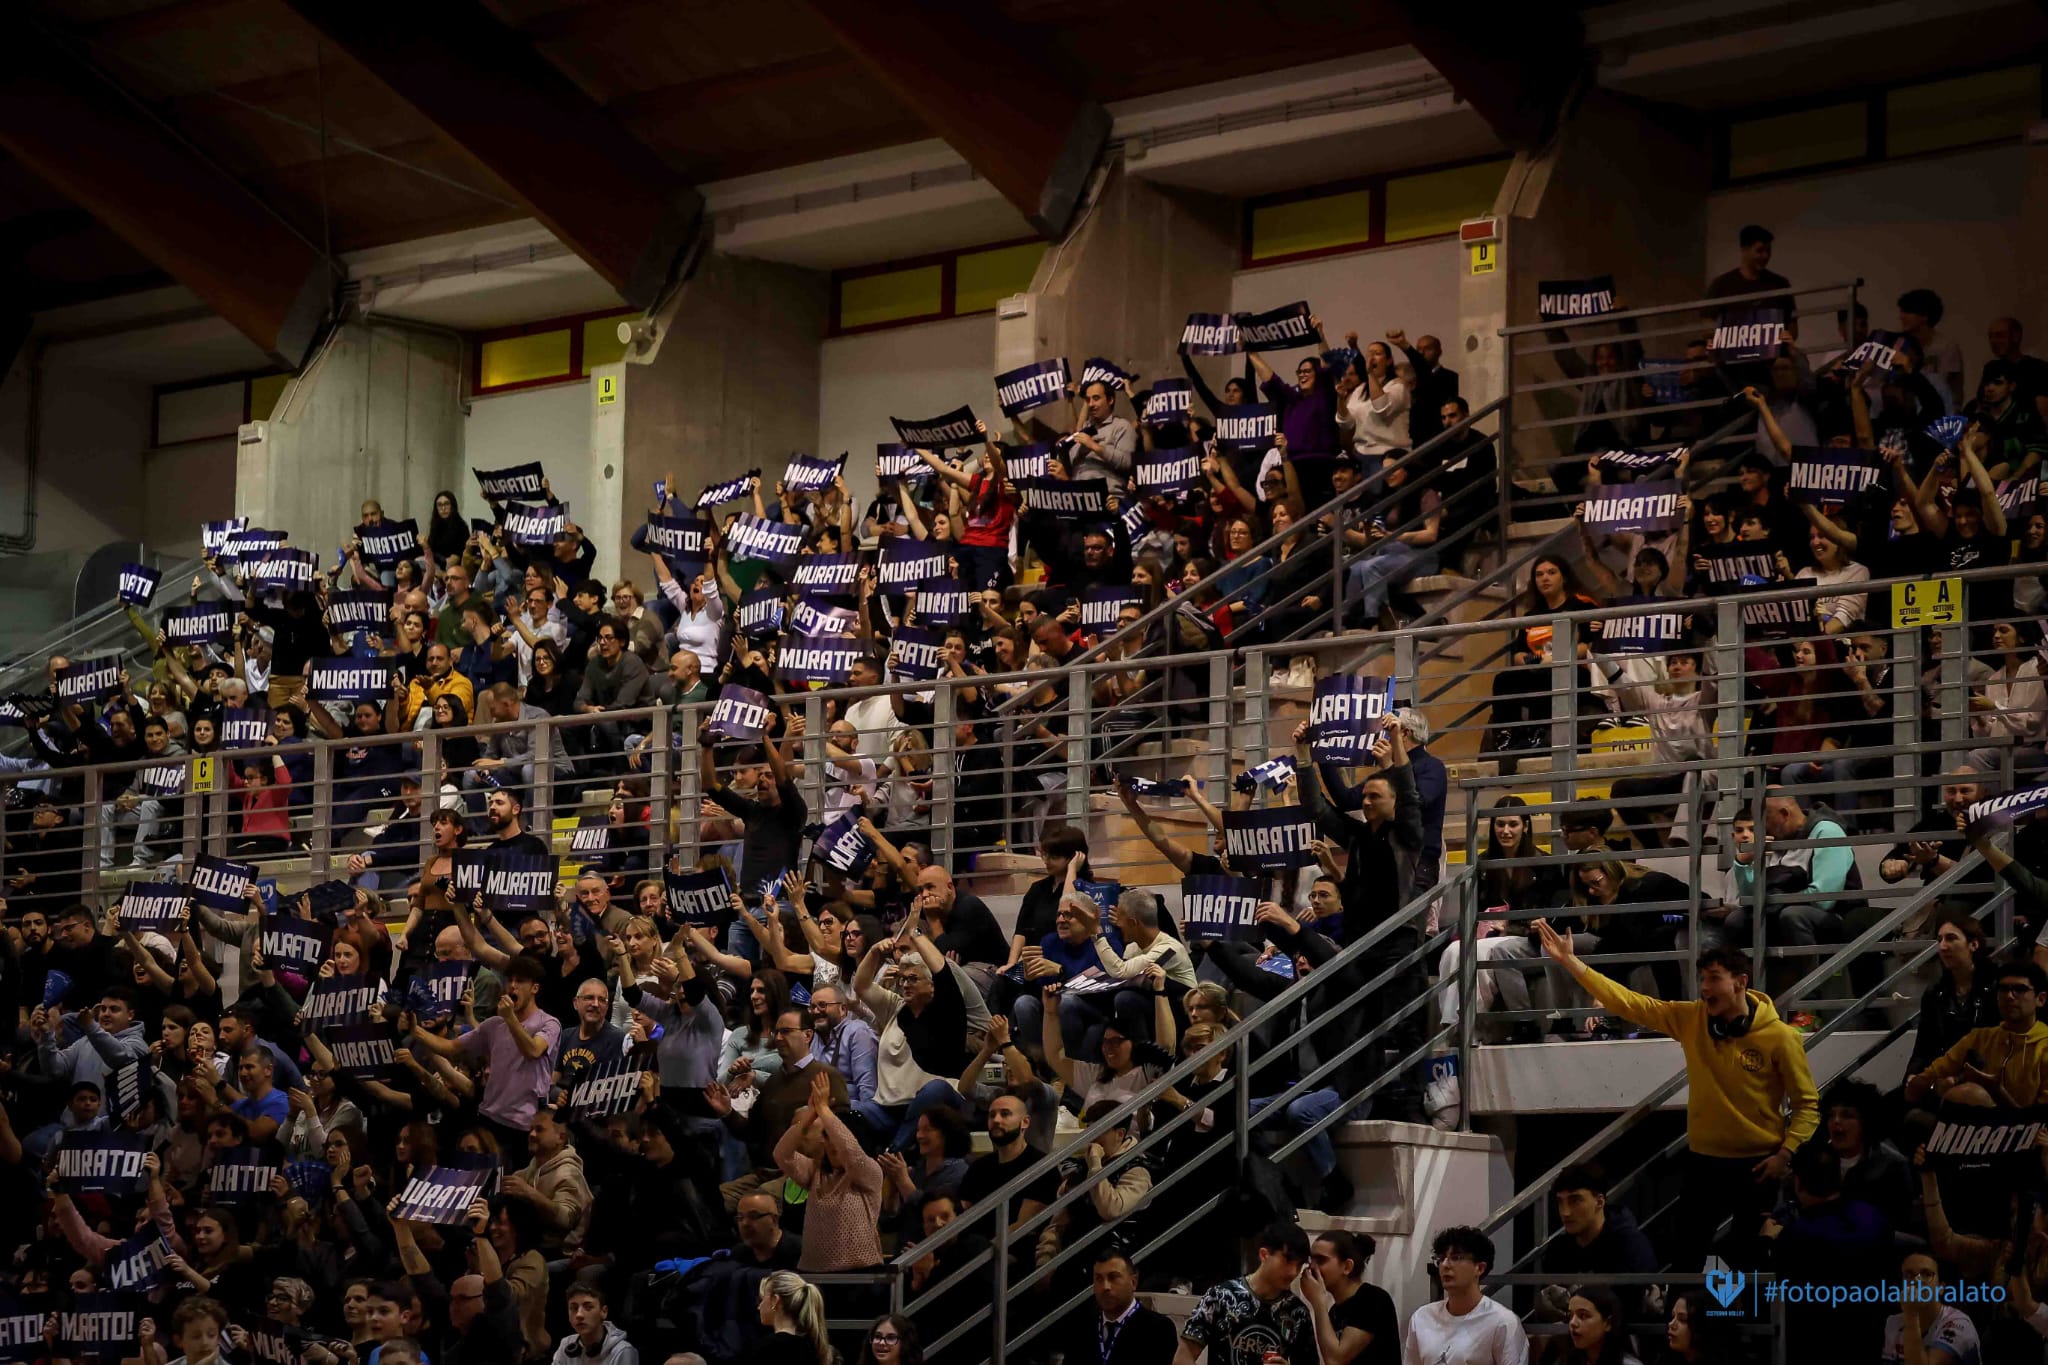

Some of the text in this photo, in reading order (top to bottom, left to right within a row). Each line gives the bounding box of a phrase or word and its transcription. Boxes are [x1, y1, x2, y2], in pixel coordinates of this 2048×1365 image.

[1479, 243, 1488, 260] D
[1540, 289, 1613, 316] MURATO!
[1242, 315, 1309, 343] MURATO!
[604, 378, 611, 393] D
[1000, 370, 1066, 407] MURATO!
[903, 419, 971, 444] MURATO!
[1217, 414, 1277, 439] MURATO!
[1137, 455, 1200, 486] MURATO!
[1791, 462, 1880, 492] MURATO!
[482, 473, 541, 497] MURATO!
[1029, 489, 1102, 511] MURATO!
[1584, 494, 1676, 523] MURATO!
[504, 512, 565, 536] MURATO!
[647, 522, 702, 552] MURATO!
[728, 522, 801, 555] MURATO!
[793, 563, 858, 585] MURATO!
[880, 555, 945, 583] MURATO!
[916, 591, 972, 614] MURATO!
[1904, 583, 1917, 606] C
[1937, 580, 1950, 603] A
[328, 602, 387, 623] MURATO!
[1082, 599, 1143, 625] MURA
[1898, 606, 1921, 616] SETTORE
[1932, 603, 1955, 613] SETTORE
[168, 611, 229, 638] MURATO!
[778, 648, 864, 672] MURATO
[57, 665, 119, 697] MURATO!
[312, 669, 387, 691] MURATO!
[199, 760, 207, 778] C
[1226, 821, 1316, 857] MURATO!
[486, 871, 552, 896] MURATO!
[1183, 893, 1262, 926] MURATO!
[302, 986, 376, 1020] MURATO!
[59, 1149, 147, 1178] MURATO!
[400, 1177, 482, 1211] MURATO!
[61, 1311, 135, 1342] MURATO!
